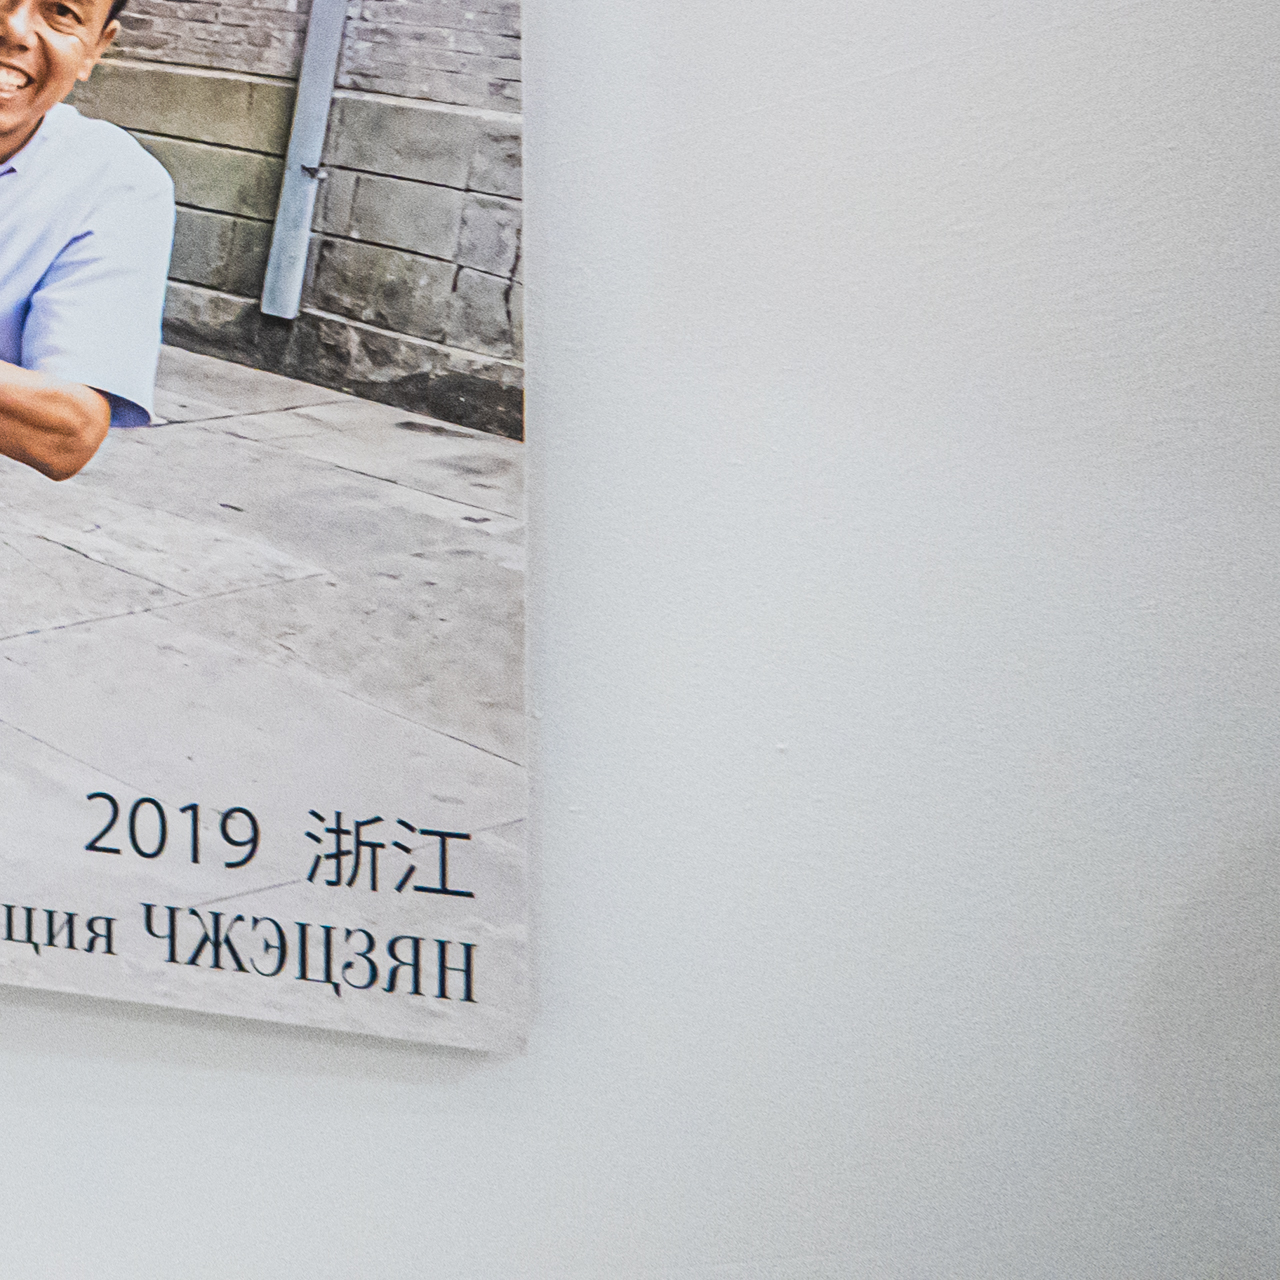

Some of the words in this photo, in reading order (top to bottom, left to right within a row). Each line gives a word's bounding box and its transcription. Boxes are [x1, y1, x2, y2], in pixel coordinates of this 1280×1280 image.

[85, 791, 261, 868] 2019
[304, 809, 476, 899] 浙江
[141, 903, 479, 1003] ЧЖЭЦЗЯН
